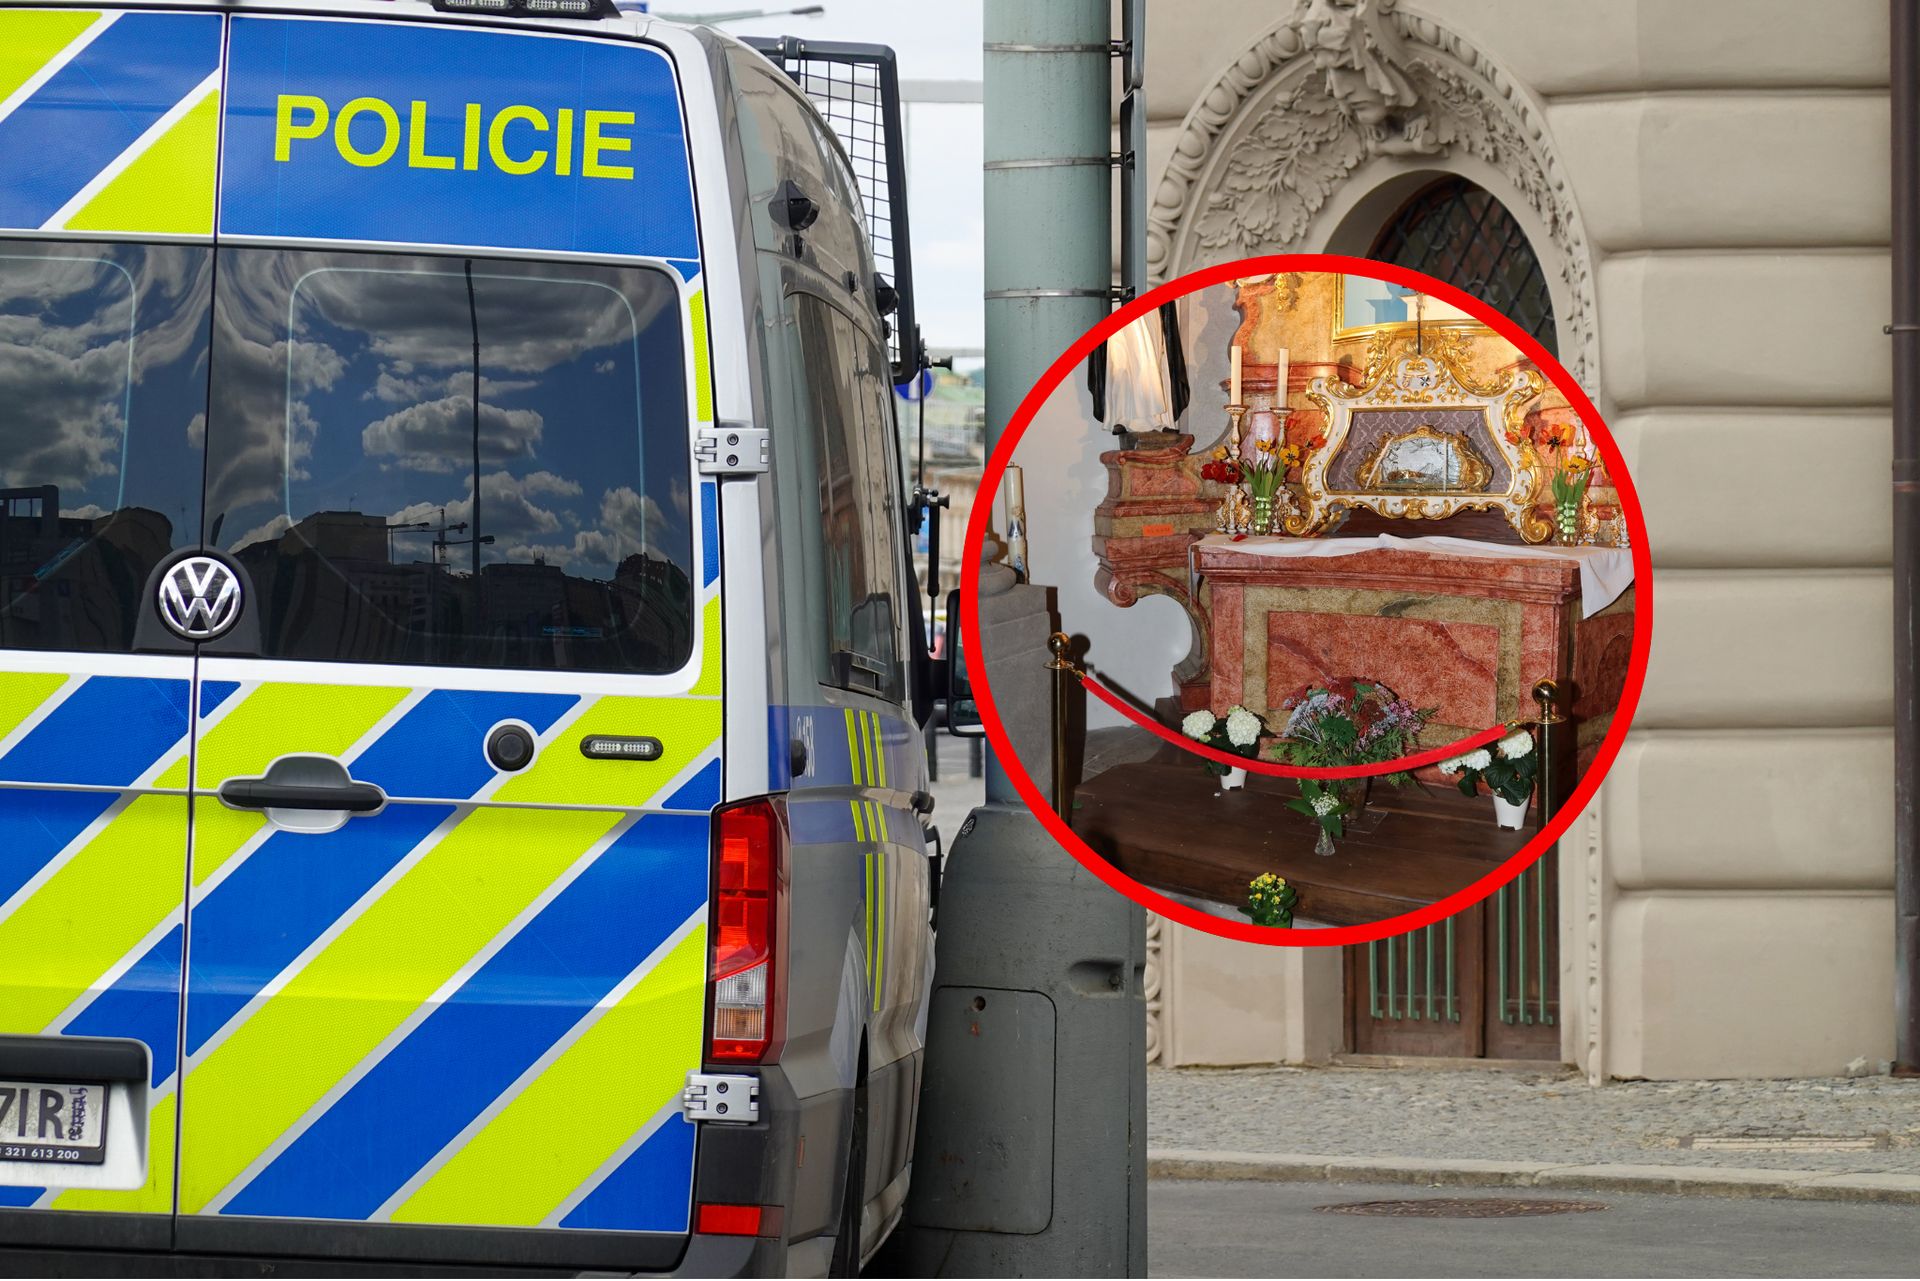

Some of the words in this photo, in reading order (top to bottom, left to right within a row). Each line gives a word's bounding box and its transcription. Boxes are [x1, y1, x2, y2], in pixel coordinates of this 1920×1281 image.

[274, 94, 636, 180] POLICIE
[159, 556, 241, 639] VW
[5, 1147, 26, 1157] 321
[31, 1148, 53, 1158] 613
[57, 1150, 79, 1159] 200
